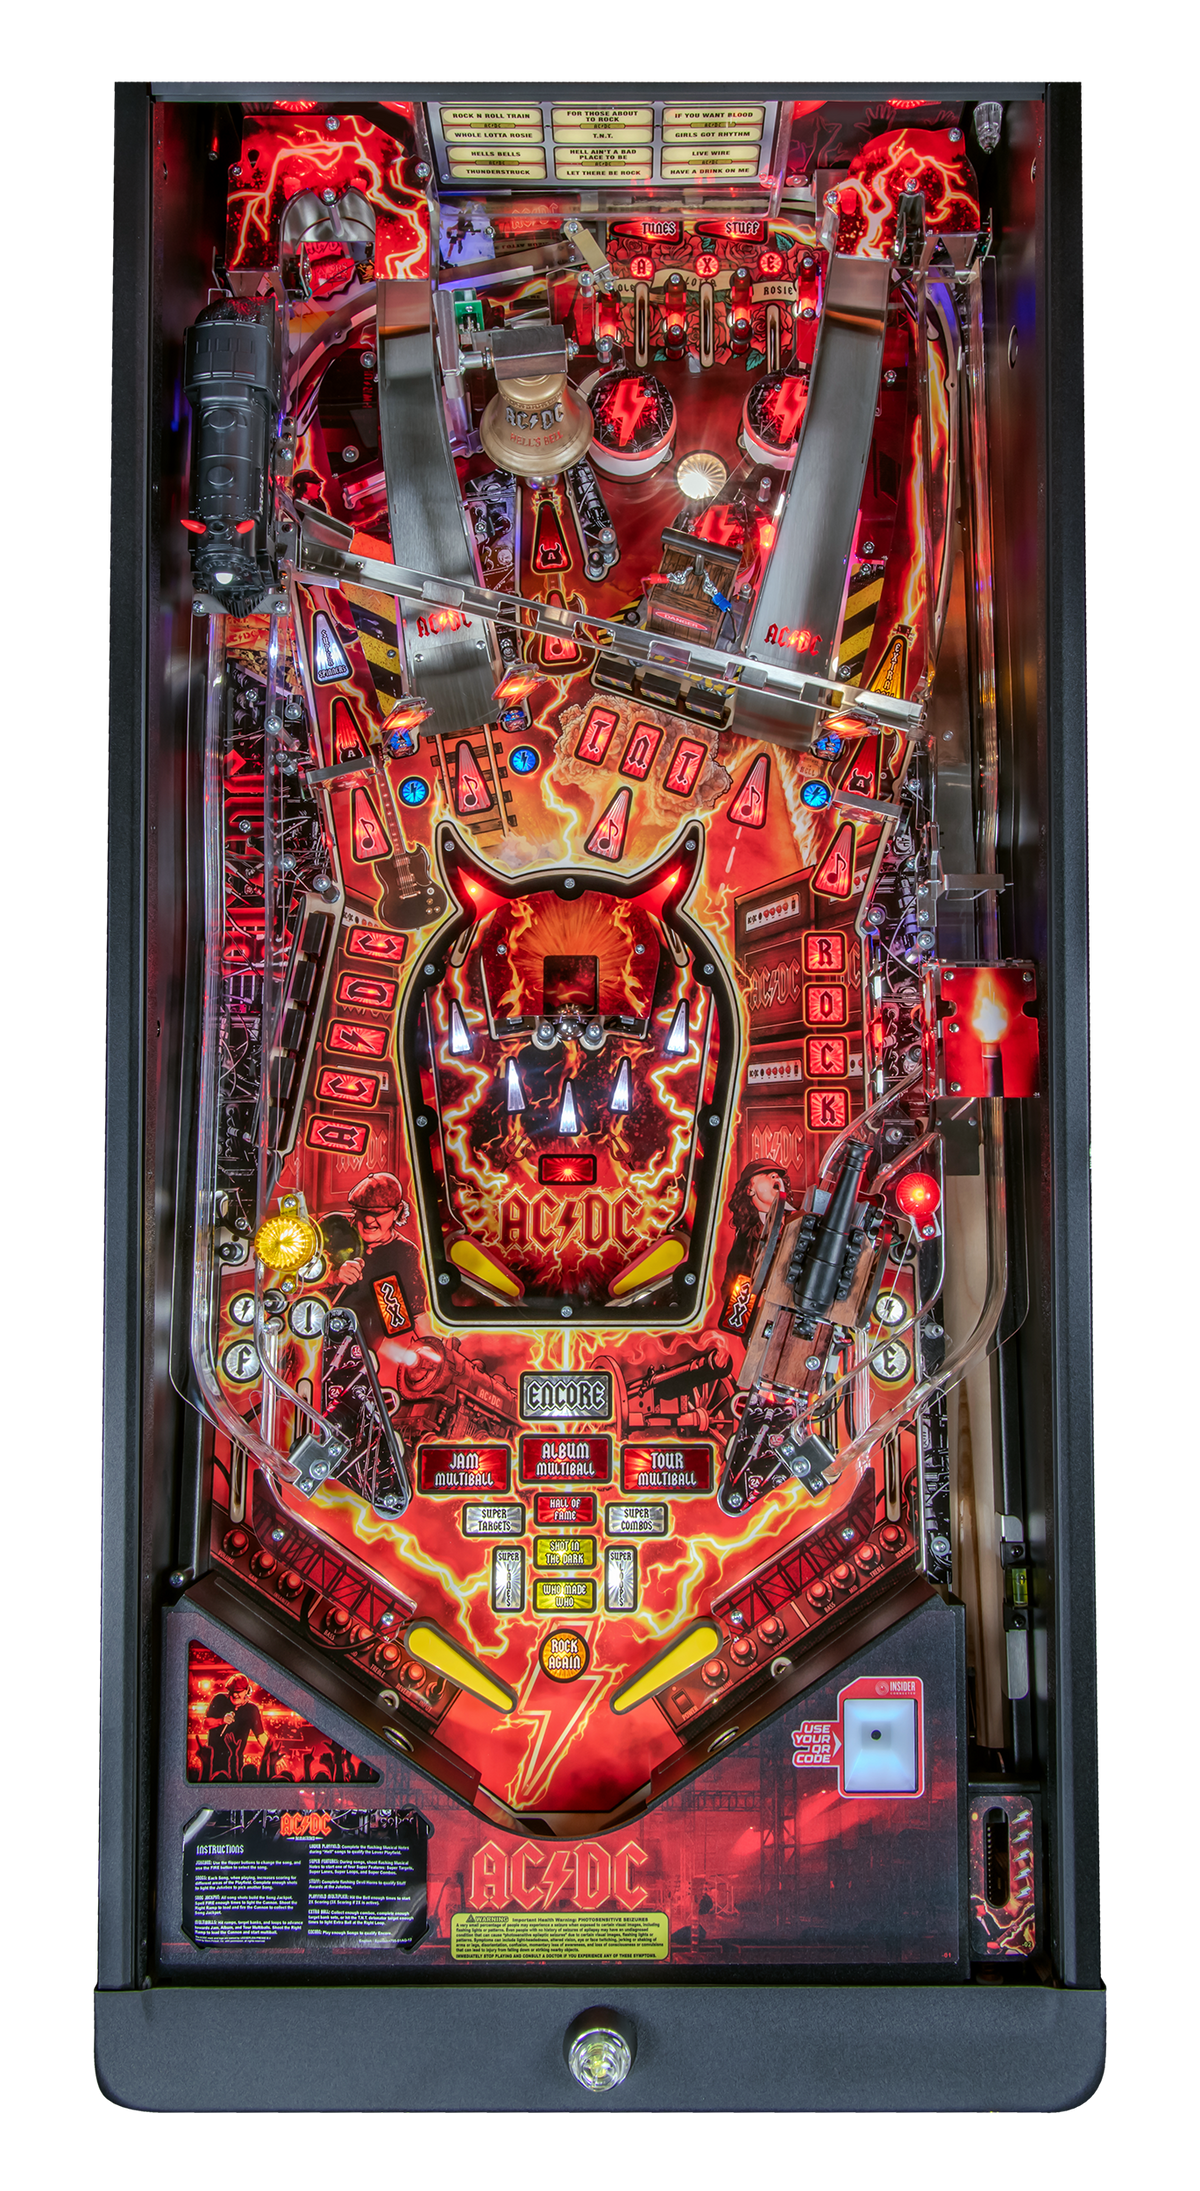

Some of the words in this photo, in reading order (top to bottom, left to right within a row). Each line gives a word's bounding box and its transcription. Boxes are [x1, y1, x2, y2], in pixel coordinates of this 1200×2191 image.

[641, 222, 676, 236] TUNES
[725, 222, 760, 235] STUFF
[703, 257, 712, 273] X
[764, 286, 793, 296] ROSIE
[510, 432, 541, 447] HELL'S
[544, 430, 563, 446] BELL
[664, 614, 699, 628] DANGER
[318, 665, 346, 679] SPINNERS
[884, 643, 901, 690] EXTRA
[501, 1189, 643, 1252] AC/DC
[527, 1380, 606, 1411] ENCORE
[541, 1442, 590, 1460] ALBUM
[449, 1452, 479, 1470] JAM
[650, 1452, 685, 1470] TOUR
[536, 1461, 596, 1477] MULTIBALL
[434, 1472, 494, 1487] MULTIBALL
[637, 1472, 697, 1487] MULTIBALL
[550, 1498, 568, 1509] HALL
[571, 1498, 581, 1509] OF
[481, 1509, 507, 1519] SUPER
[554, 1510, 577, 1521] FAME
[624, 1509, 650, 1519] SUPER
[478, 1520, 511, 1532] TARGETS
[621, 1520, 653, 1532] COMBOS
[550, 1541, 570, 1551] SHOT
[572, 1541, 580, 1551] IN
[498, 1552, 520, 1561] SUPER
[545, 1554, 560, 1564] THE
[563, 1553, 584, 1564] DARK
[610, 1552, 632, 1561] SUPER
[870, 1564, 885, 1577] TREBLE
[543, 1584, 562, 1595] WHO
[564, 1584, 587, 1594] MADE
[555, 1597, 574, 1607] WHO
[824, 1602, 836, 1613] BASS
[323, 1630, 336, 1640] BASS
[551, 1639, 578, 1654] ROCK
[548, 1655, 581, 1670] AGAIN
[370, 1664, 386, 1678] TREBLE
[890, 1682, 916, 1692] INSIDER
[682, 1705, 699, 1720] POWER
[804, 1725, 831, 1733] USE
[795, 1734, 830, 1743] YOUR
[812, 1744, 831, 1754] QR
[796, 1754, 831, 1764] CODE
[280, 1812, 332, 1837] AC/DC
[196, 1844, 244, 1855] INSTRUCTIONS
[469, 1840, 648, 1911] AC/DC
